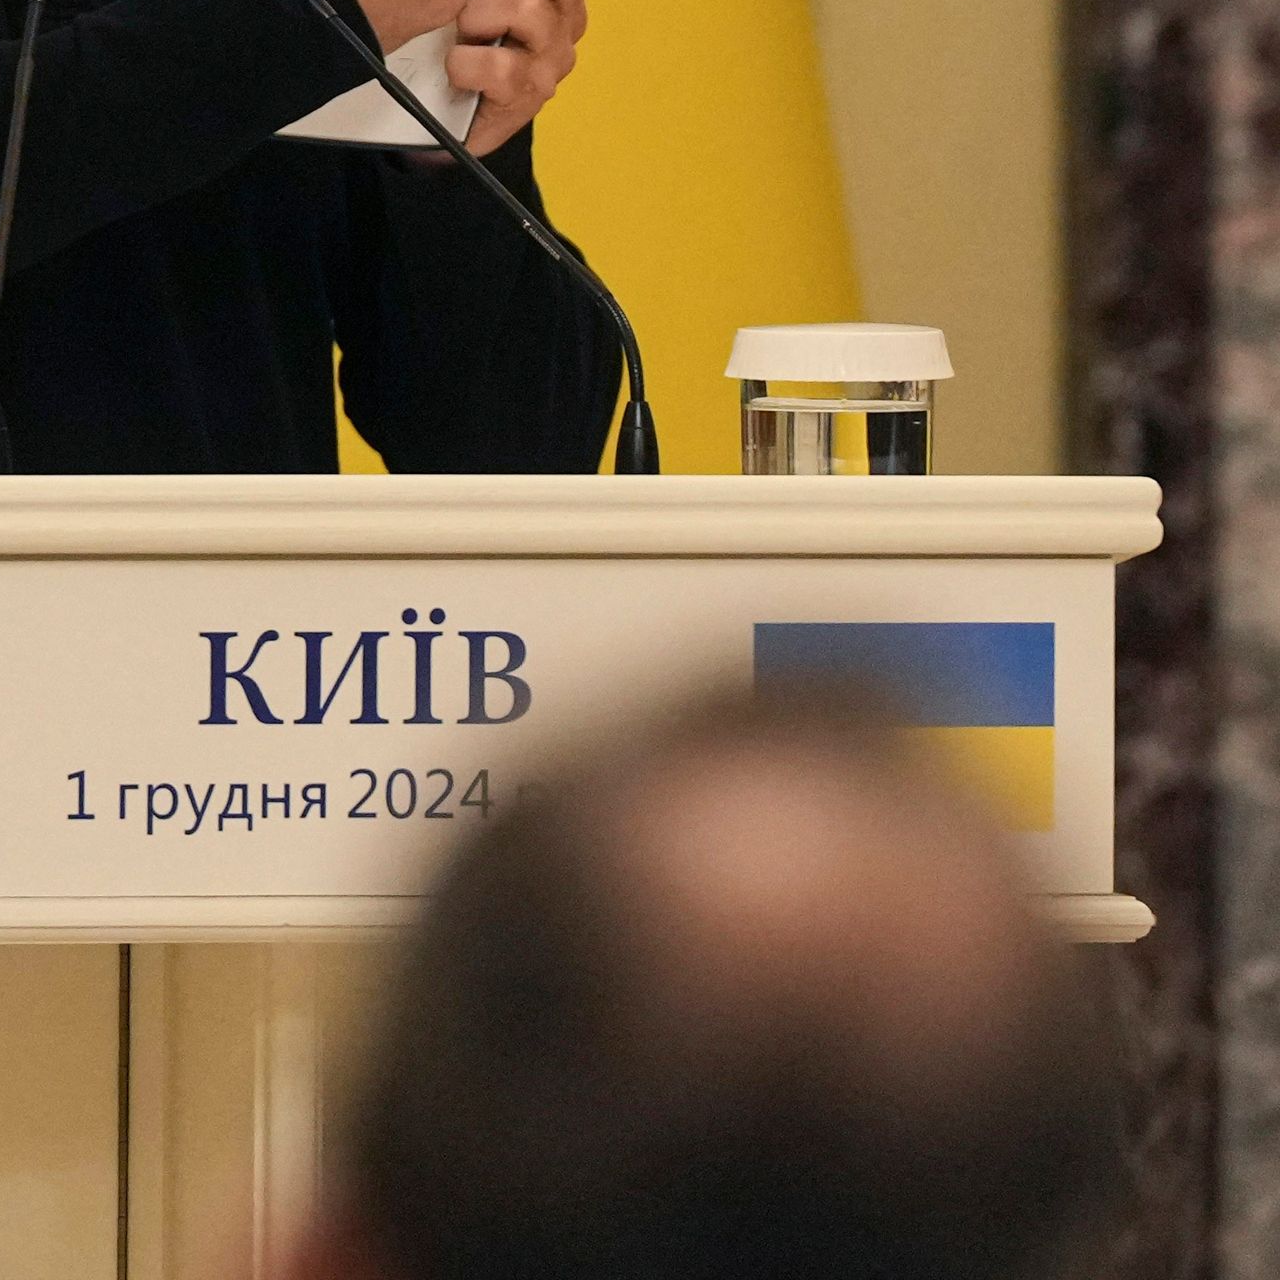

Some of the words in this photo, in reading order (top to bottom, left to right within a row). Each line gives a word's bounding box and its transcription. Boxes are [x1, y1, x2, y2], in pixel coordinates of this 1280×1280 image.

[197, 606, 532, 726] КИЇВ
[65, 770, 96, 821] 1
[118, 781, 328, 836] грудня
[346, 767, 495, 821] 2024
